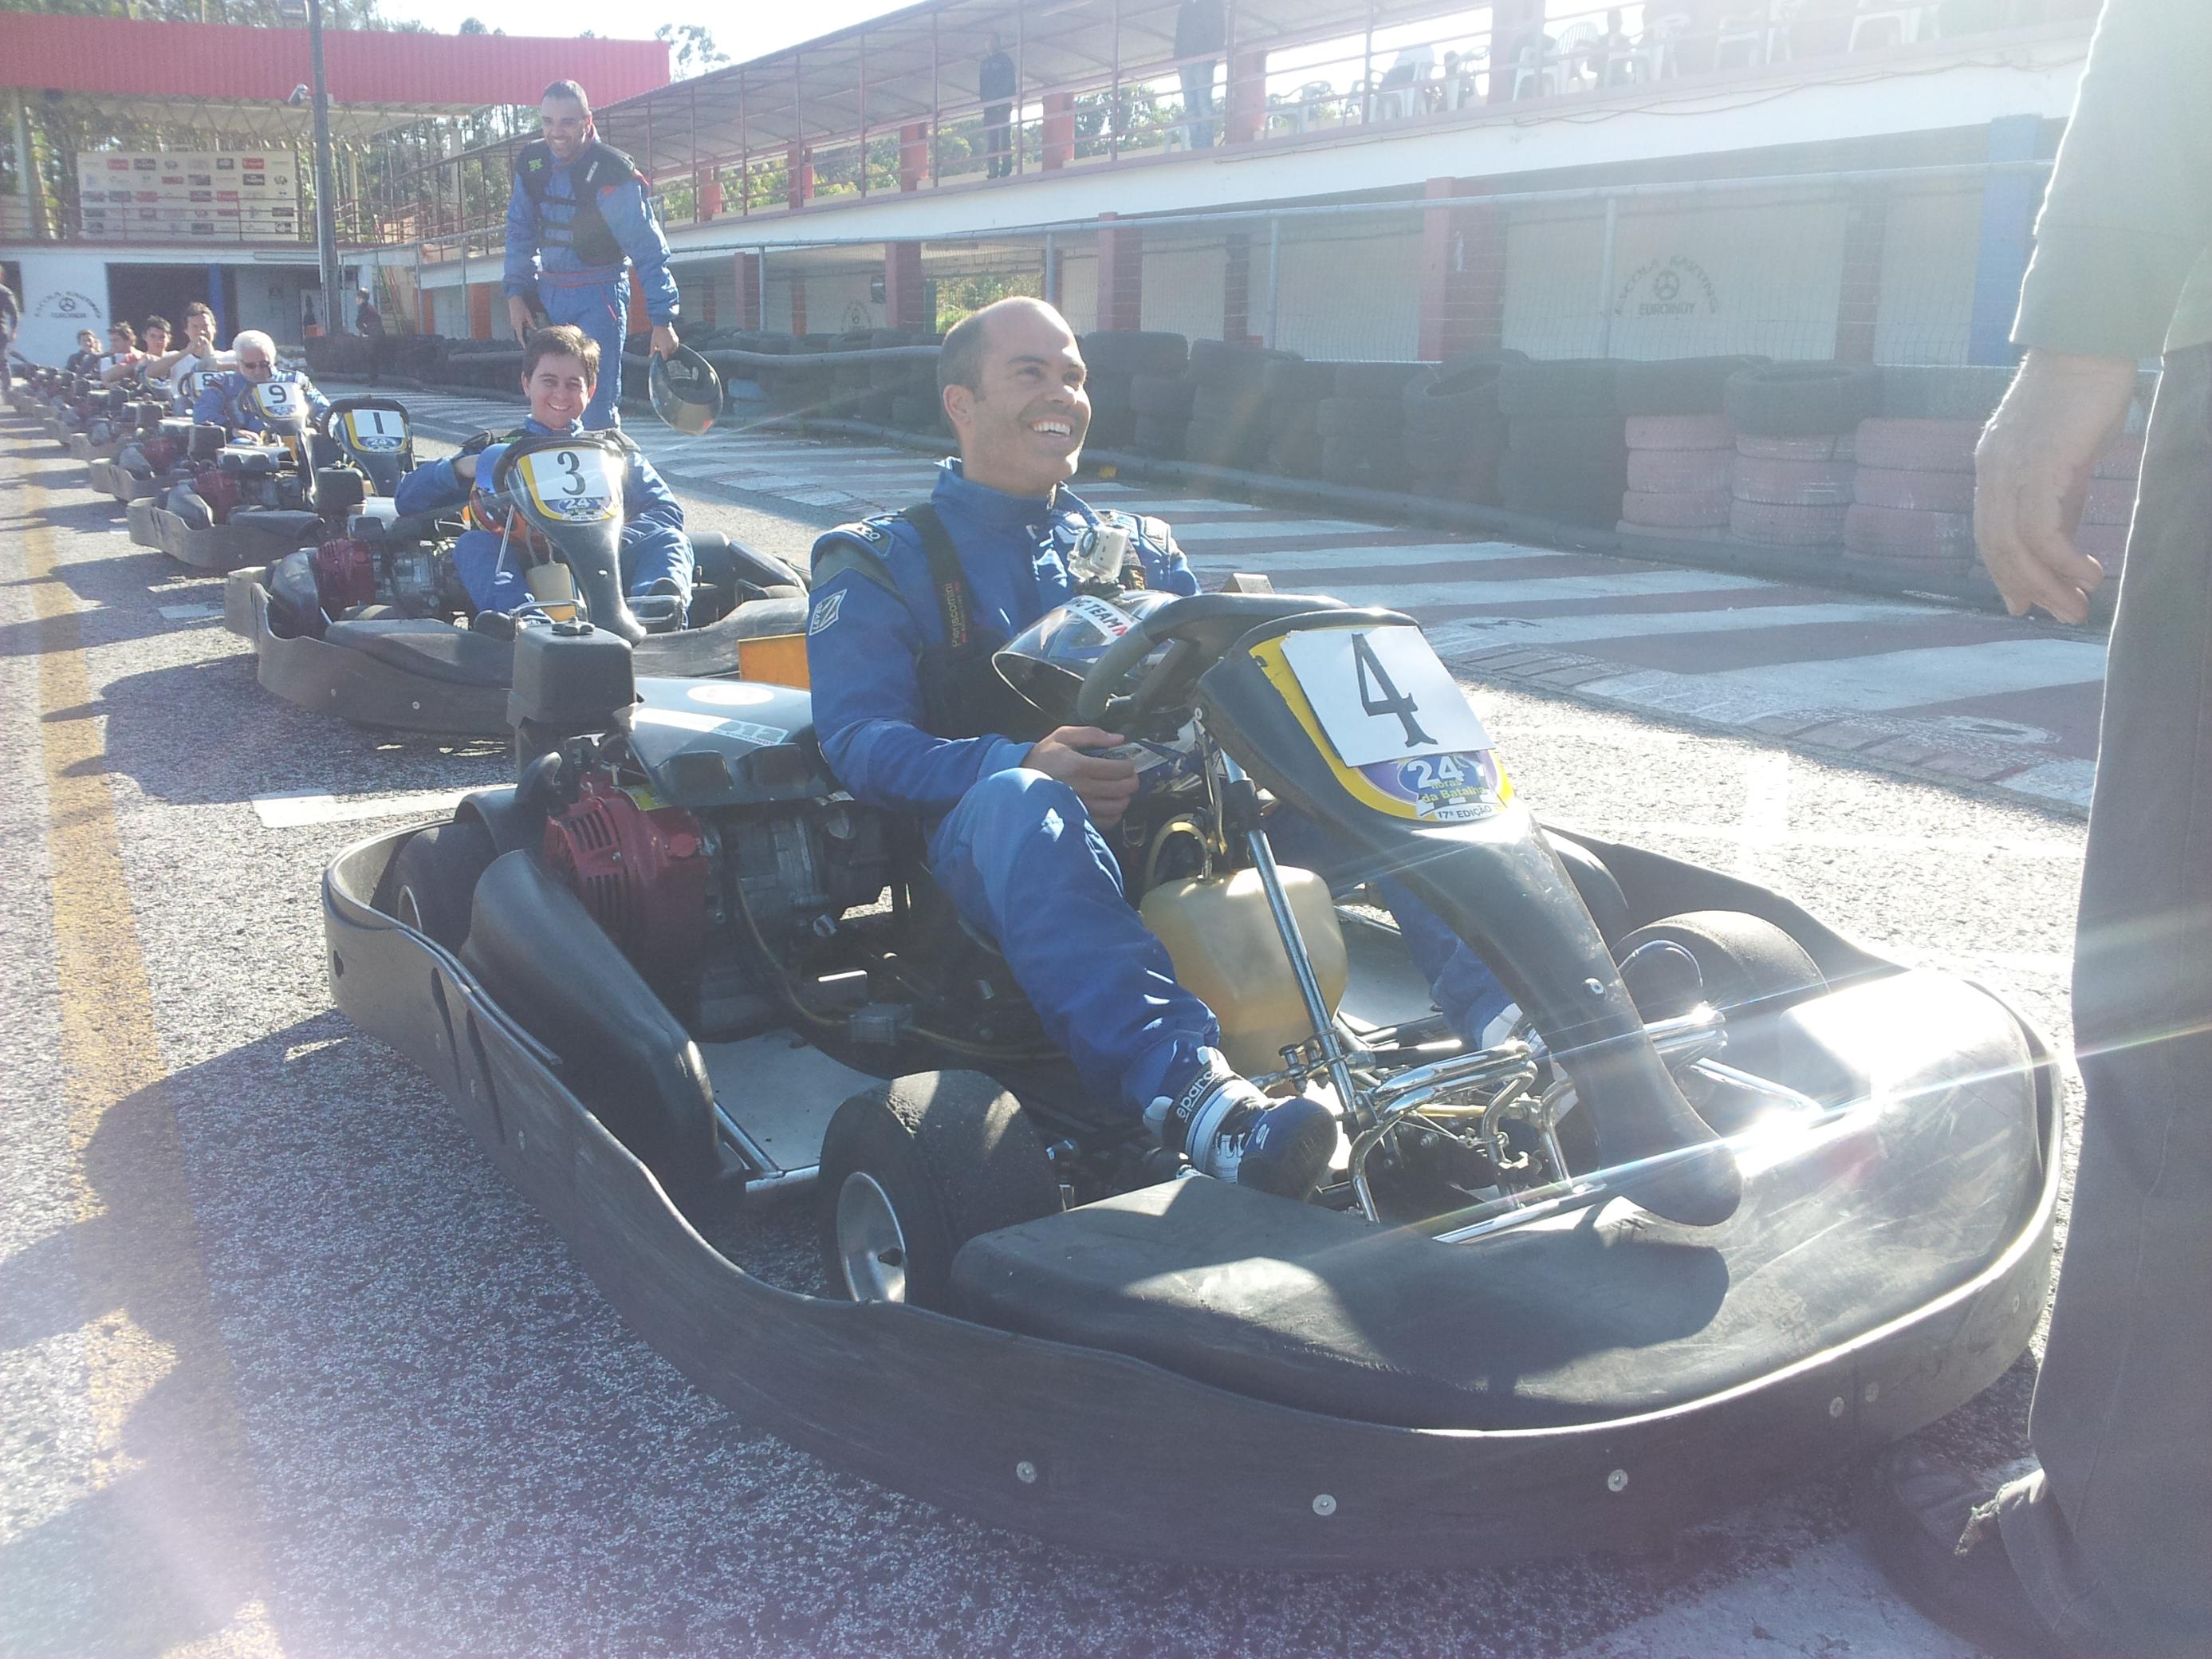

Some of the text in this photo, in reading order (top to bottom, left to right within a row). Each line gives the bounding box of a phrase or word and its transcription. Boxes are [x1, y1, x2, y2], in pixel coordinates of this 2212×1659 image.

[268, 384, 287, 404] 9
[372, 412, 384, 435] 1
[557, 451, 586, 495] 3
[564, 498, 590, 510] 24
[1351, 633, 1439, 747] 4
[1407, 755, 1465, 789] 24
[1421, 786, 1488, 803] da Batalha
[1458, 805, 1493, 818] EDIÇÃO
